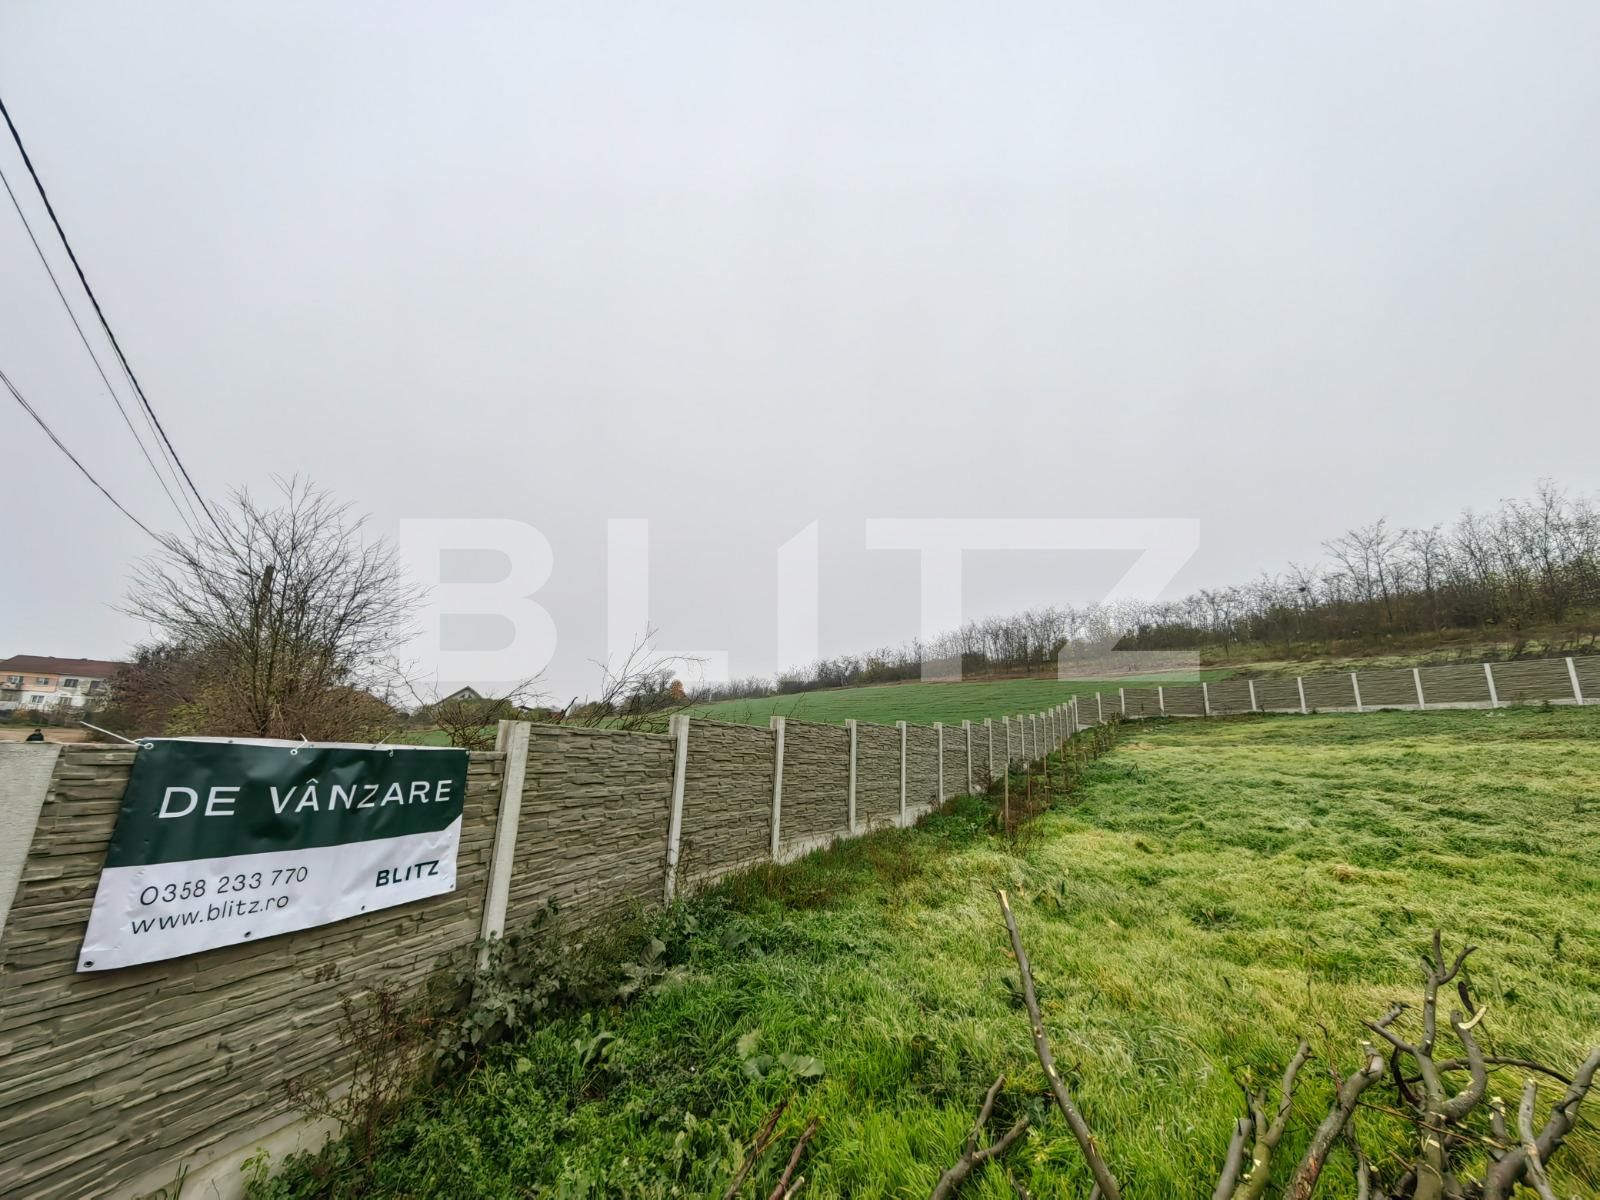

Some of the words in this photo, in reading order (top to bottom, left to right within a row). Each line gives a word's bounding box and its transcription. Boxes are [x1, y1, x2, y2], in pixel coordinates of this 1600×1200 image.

[158, 786, 240, 819] DE
[269, 777, 453, 814] VÂNZARE
[217, 872, 262, 895] 233
[270, 866, 308, 887] 770
[375, 860, 439, 888] BLITZ
[131, 895, 289, 935] www.blitz.ro
